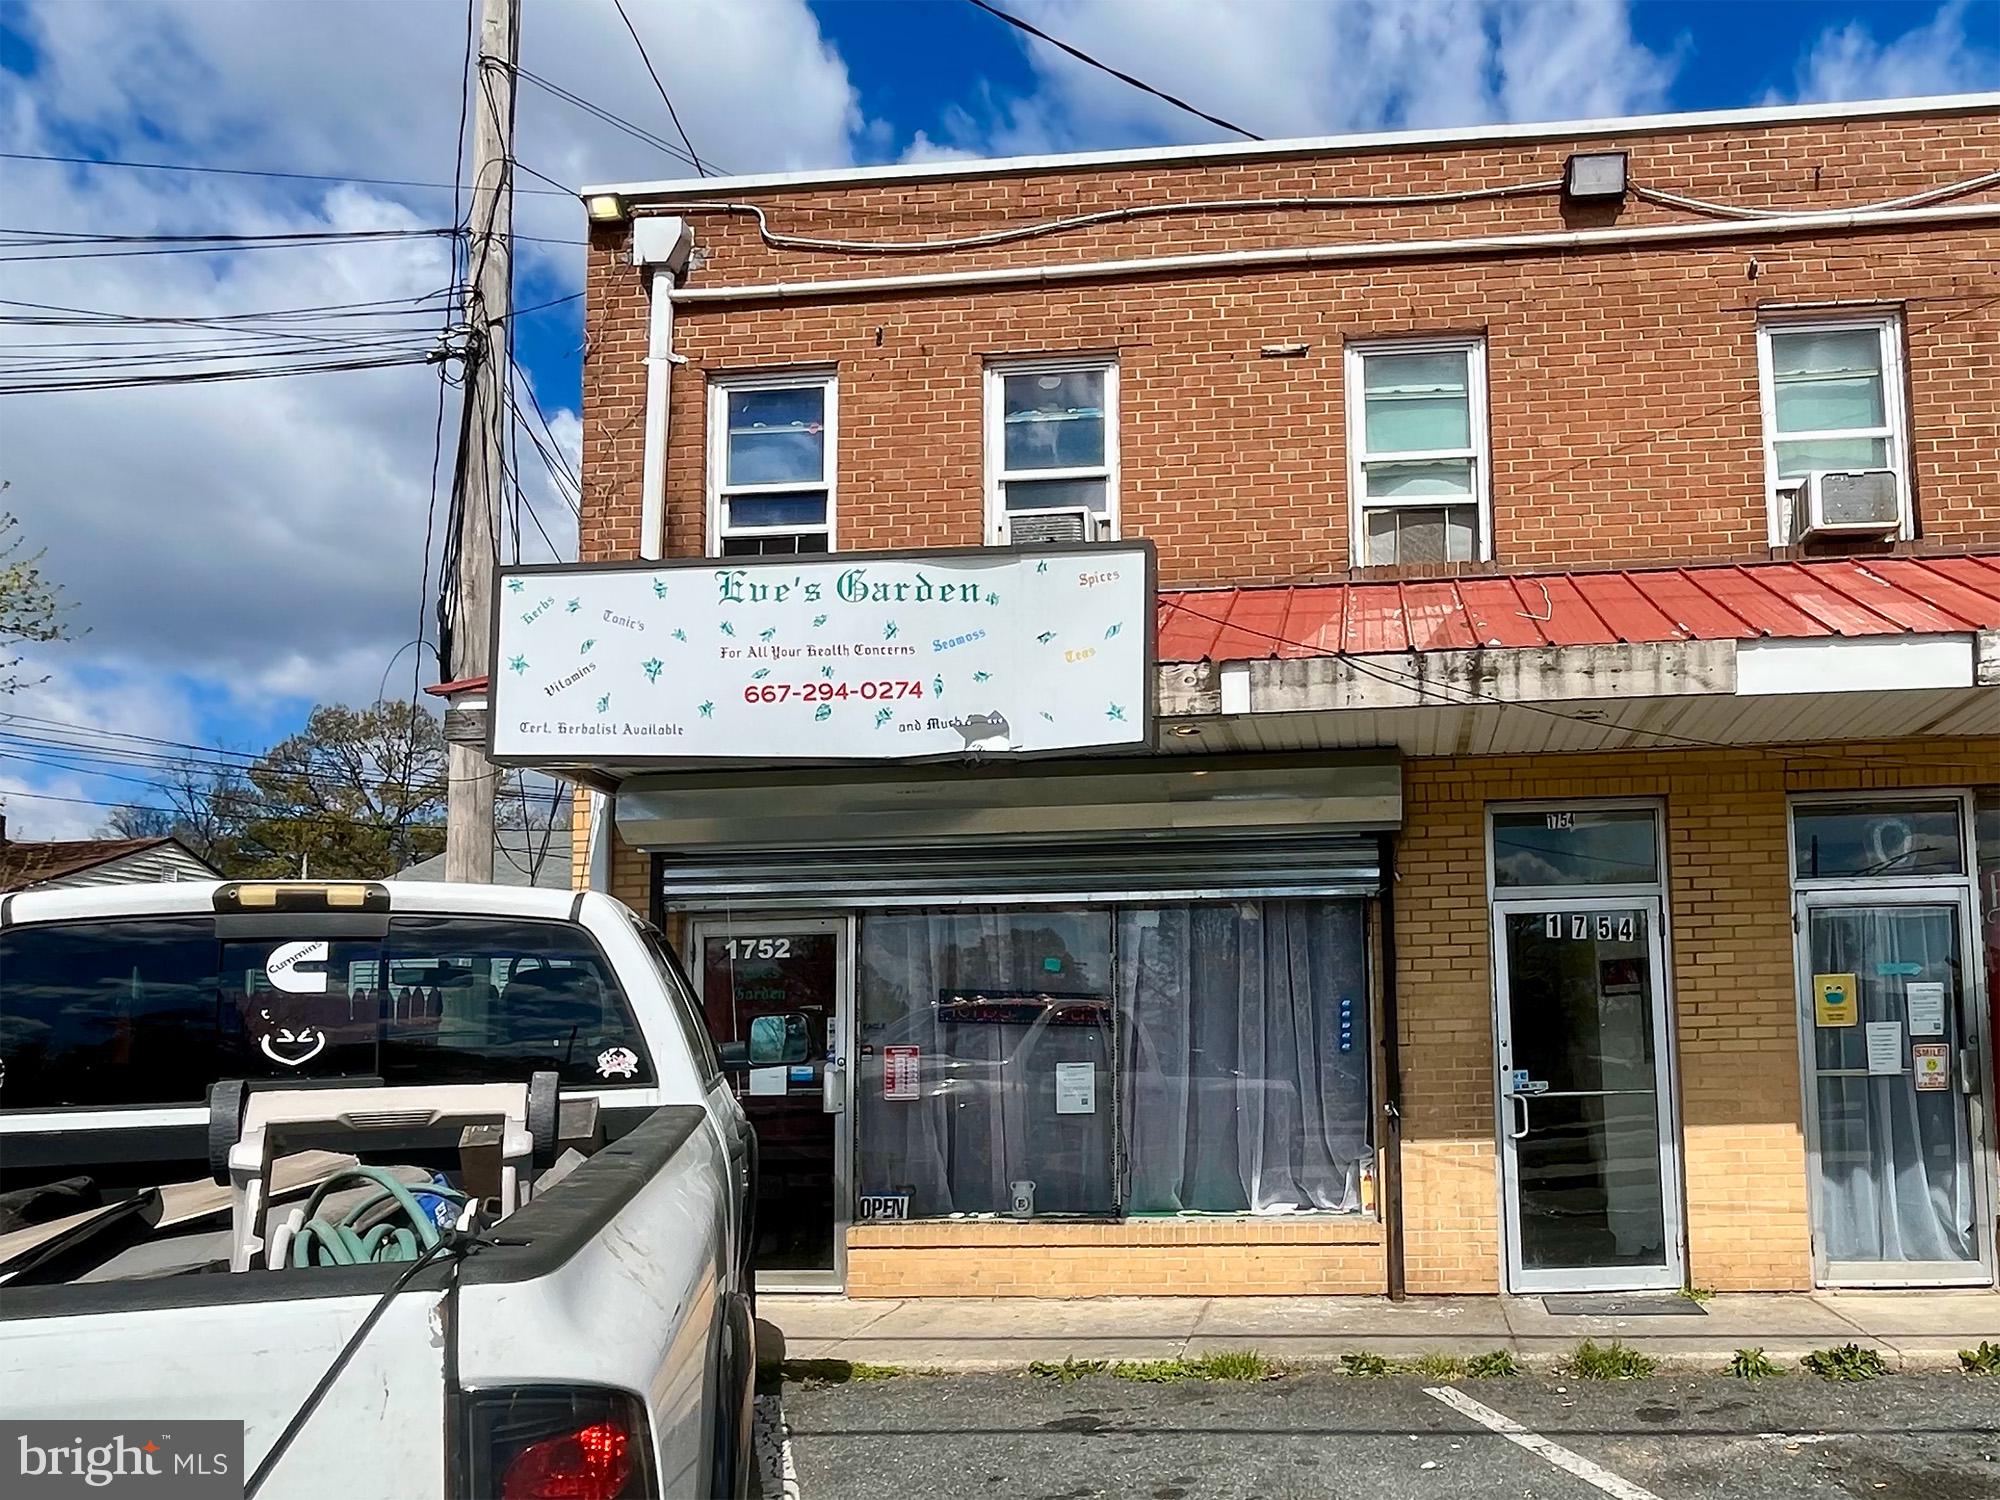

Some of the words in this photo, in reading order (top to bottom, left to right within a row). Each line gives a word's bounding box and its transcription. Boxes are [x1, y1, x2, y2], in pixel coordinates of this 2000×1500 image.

[714, 569, 822, 606] Eve's
[836, 568, 981, 604] Garden
[1078, 569, 1121, 587] Spices
[520, 595, 555, 626] Herbs
[602, 609, 647, 632] Tonic's
[719, 646, 743, 659] For
[746, 645, 768, 659] All
[770, 644, 801, 660] Your
[805, 643, 850, 657] Health
[853, 642, 916, 657] Concerns
[932, 627, 987, 652] Seamoss
[1064, 646, 1097, 664] Teas
[543, 660, 598, 698] Vitamins
[744, 680, 924, 704] 667-294-0274
[519, 721, 552, 735] Cert.
[557, 721, 618, 735] Herbalist
[622, 722, 685, 736] Available
[898, 719, 922, 732] and
[1547, 813, 1576, 829] 1754
[1548, 915, 1633, 941] 1754
[268, 942, 323, 974] Cummins
[725, 938, 791, 960] 1752
[860, 1197, 907, 1220] OPEN
